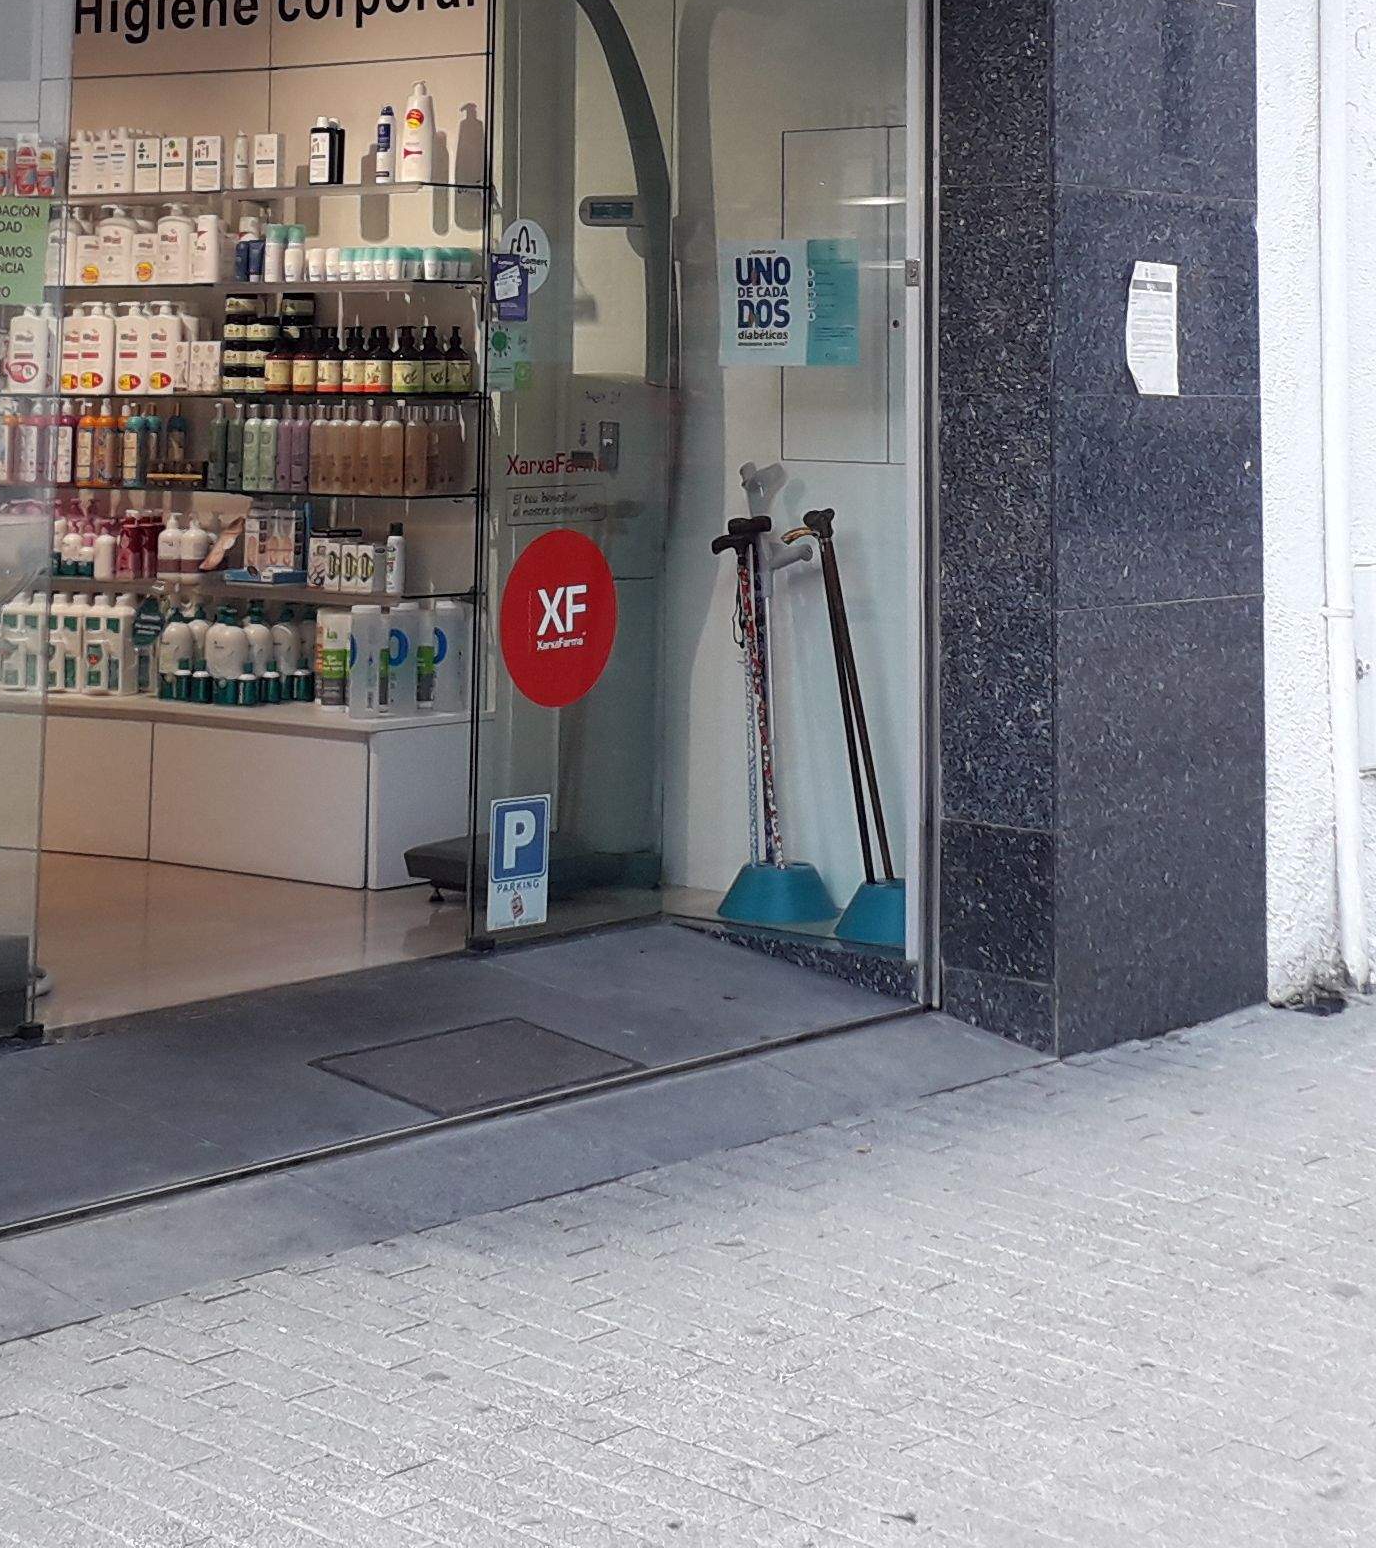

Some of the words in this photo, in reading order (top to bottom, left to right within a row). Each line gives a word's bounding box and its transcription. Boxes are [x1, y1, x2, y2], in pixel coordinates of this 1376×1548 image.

[735, 256, 792, 286] UNO
[737, 286, 754, 298] DE
[756, 286, 789, 298] CADA
[737, 298, 791, 329] DOS
[737, 329, 789, 341] diabéticos
[536, 583, 588, 636] XF
[536, 636, 585, 651] XarxaFarma
[502, 808, 537, 871] P
[496, 878, 540, 894] PARKING
